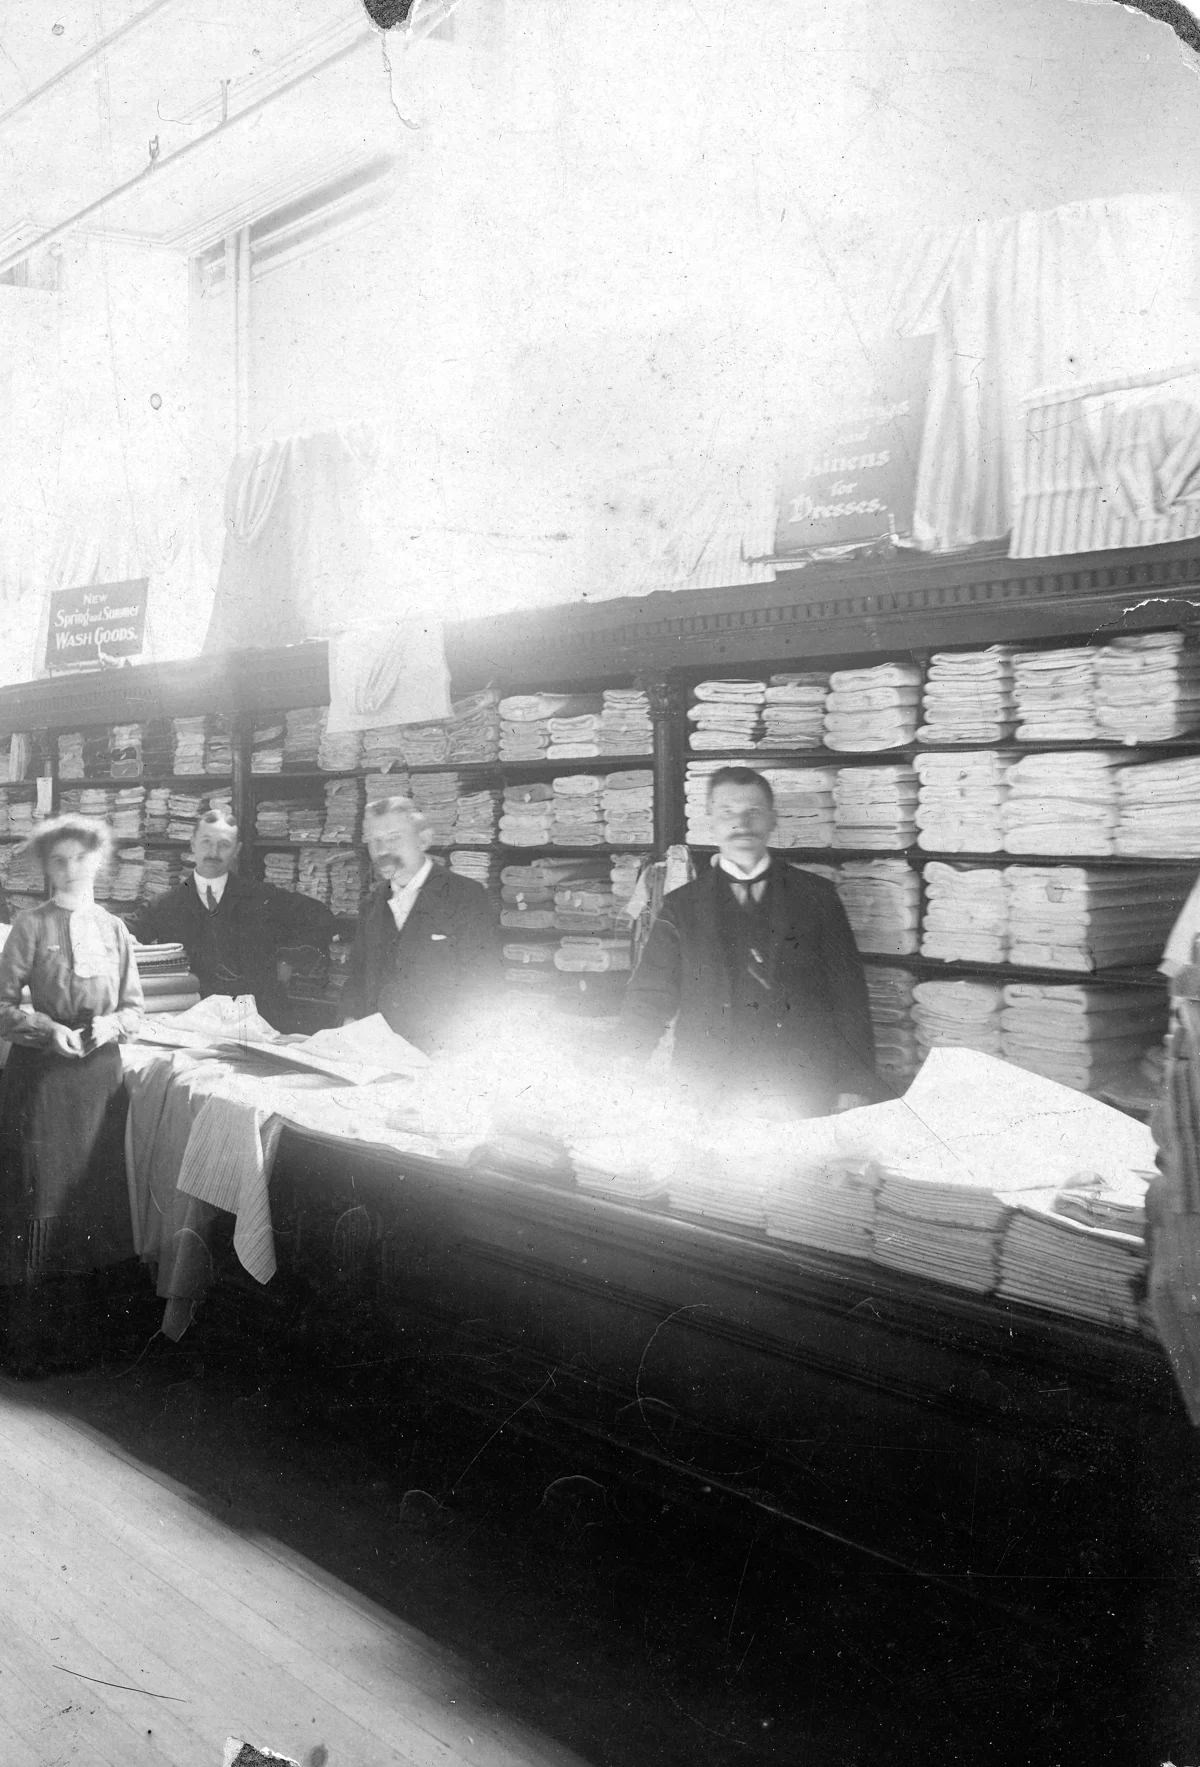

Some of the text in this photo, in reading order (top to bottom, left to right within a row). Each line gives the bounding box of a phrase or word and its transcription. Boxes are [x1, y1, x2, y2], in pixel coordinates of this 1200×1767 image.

[830, 479, 858, 497] for
[788, 493, 888, 523] Dresses.
[83, 593, 108, 605] NEW
[54, 608, 90, 628] Spring
[103, 605, 140, 620] Summer
[55, 626, 138, 650] WASH GOODS.
